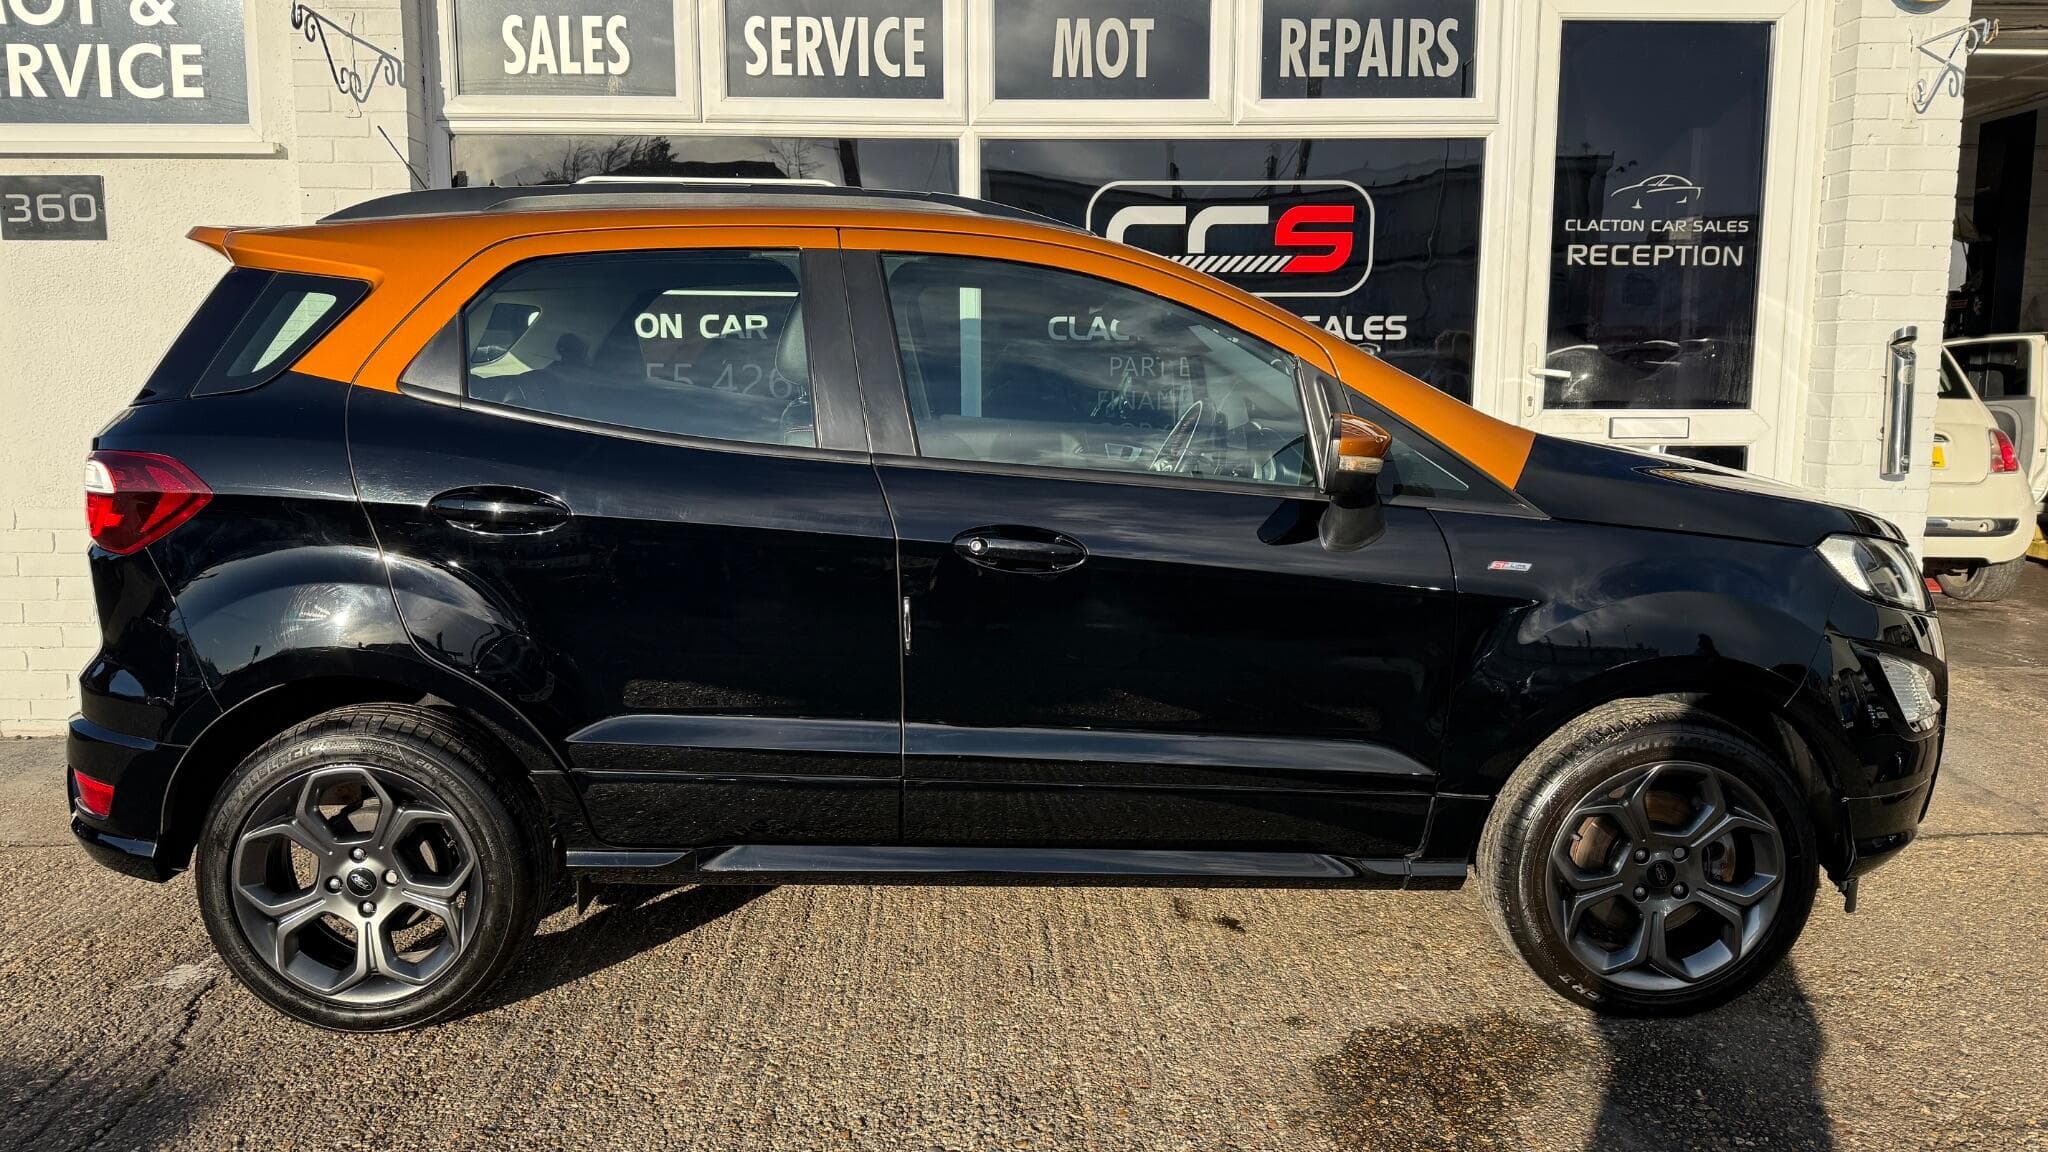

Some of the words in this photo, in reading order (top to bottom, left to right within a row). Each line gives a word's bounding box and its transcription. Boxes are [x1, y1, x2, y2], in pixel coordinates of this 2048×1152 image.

[501, 14, 631, 76] SALES
[744, 15, 926, 78] SERVICE
[1051, 17, 1155, 79] MOT
[1279, 18, 1459, 78] REPAIRS
[0, 42, 205, 99] RVICE
[5, 194, 97, 222] 360
[1565, 219, 1645, 232] CLACTON
[1651, 219, 1687, 232] CAR
[1692, 220, 1749, 233] SALES
[1567, 244, 1744, 266] RECEPTION
[700, 314, 768, 340] CAR
[1048, 316, 1132, 341] CLAC
[1301, 315, 1408, 341] ALES
